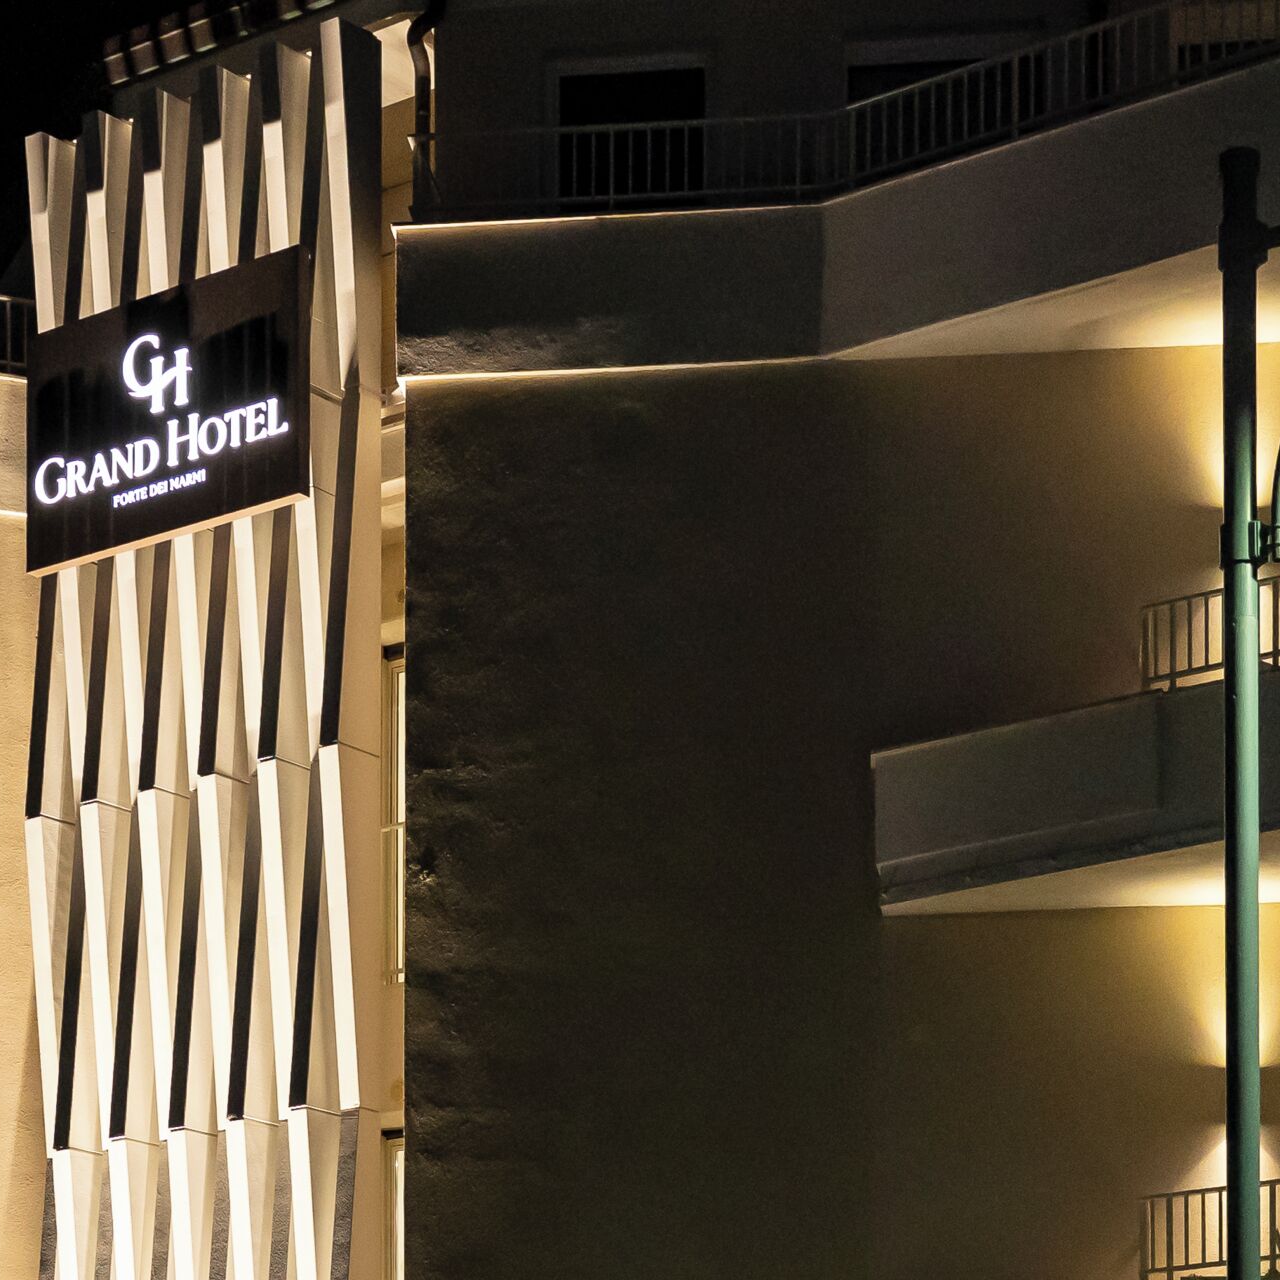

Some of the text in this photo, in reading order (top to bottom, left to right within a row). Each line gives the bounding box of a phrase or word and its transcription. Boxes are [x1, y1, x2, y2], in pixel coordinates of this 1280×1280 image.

[34, 397, 289, 504] GRAND HOTEL
[112, 486, 149, 508] FORTE
[148, 480, 169, 498] DEI
